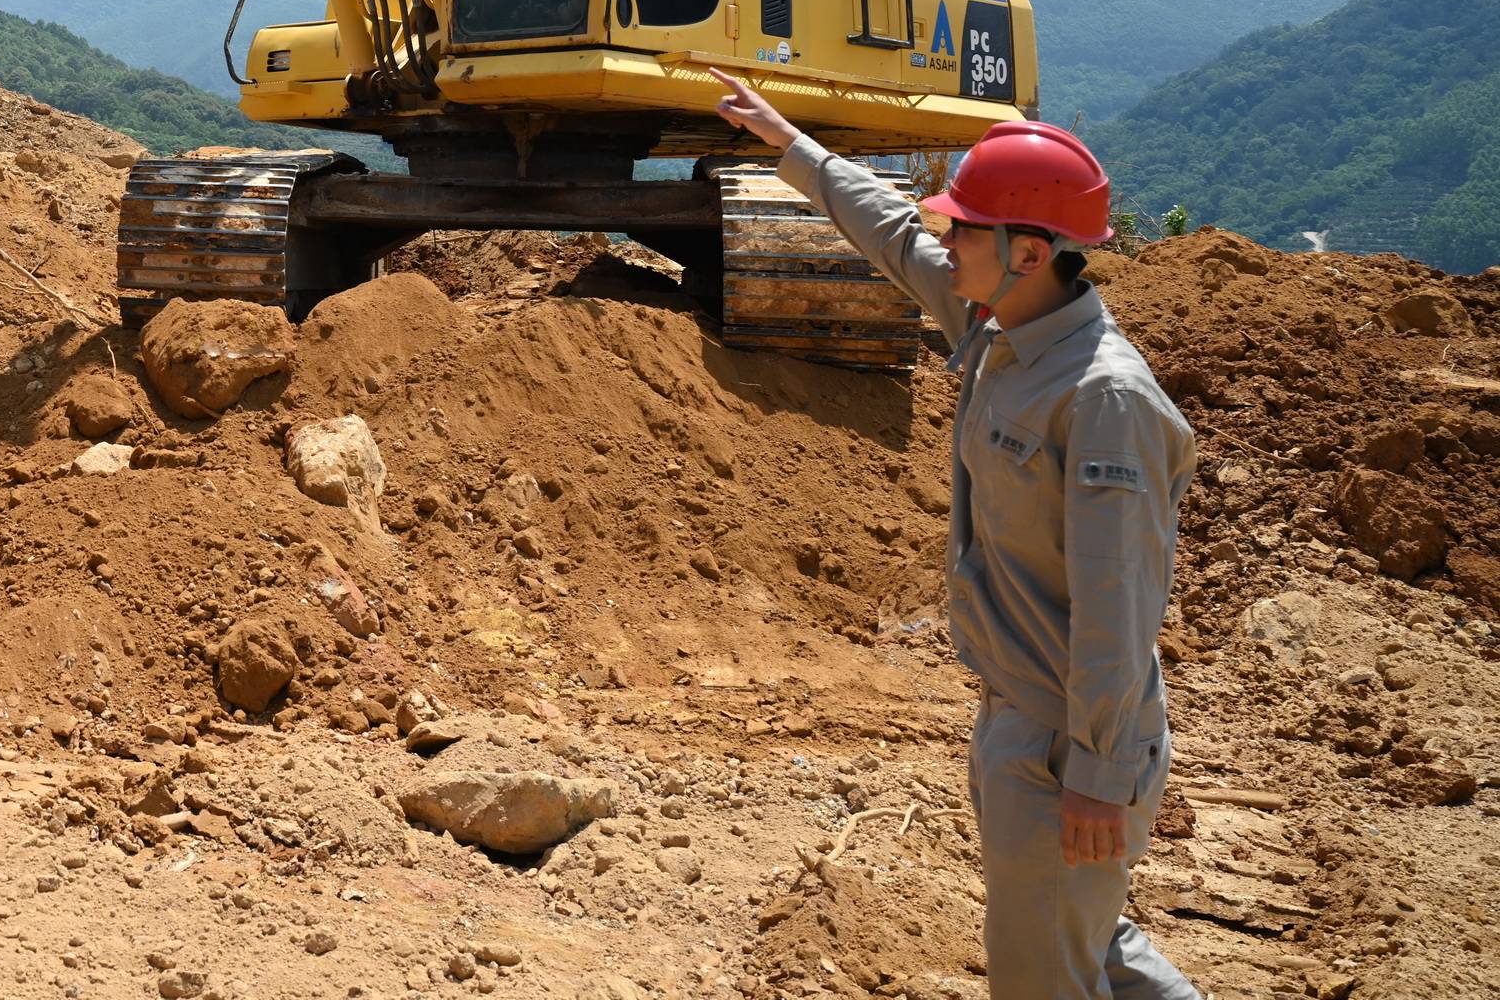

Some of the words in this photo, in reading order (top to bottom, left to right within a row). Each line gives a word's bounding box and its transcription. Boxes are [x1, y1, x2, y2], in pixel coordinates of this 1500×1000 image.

[970, 29, 990, 53] PC
[929, 57, 957, 73] ASAHI
[971, 54, 1007, 84] 350
[971, 81, 985, 96] LC
